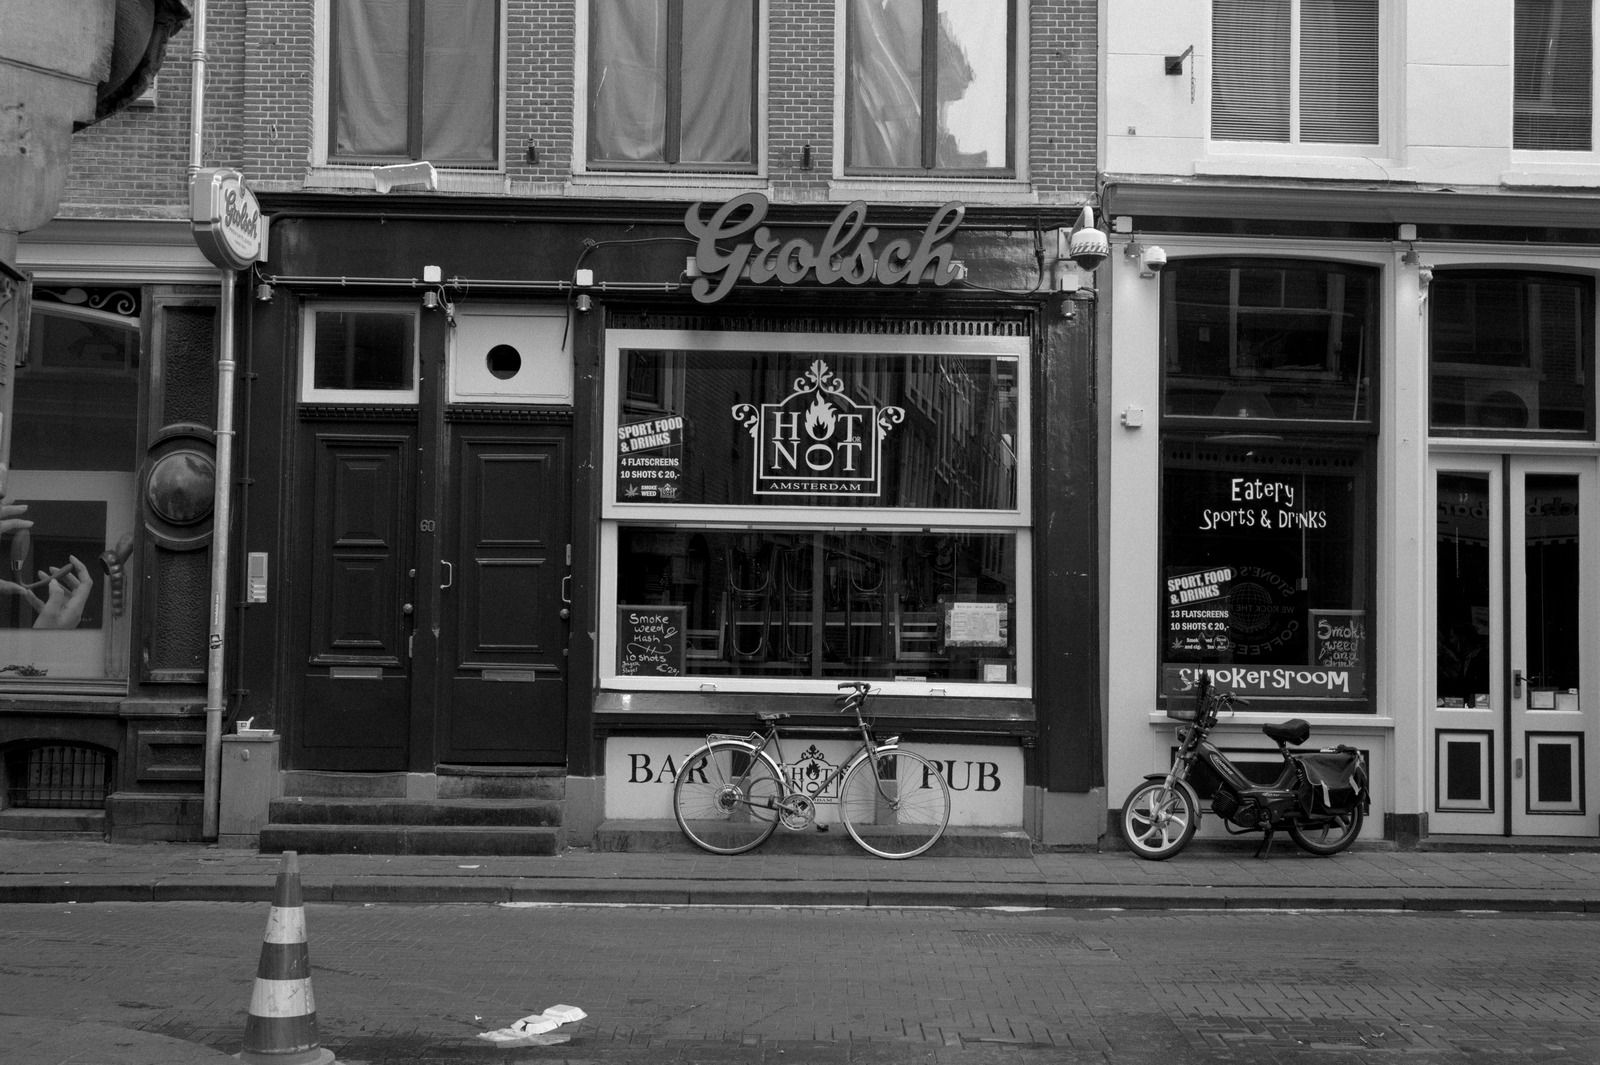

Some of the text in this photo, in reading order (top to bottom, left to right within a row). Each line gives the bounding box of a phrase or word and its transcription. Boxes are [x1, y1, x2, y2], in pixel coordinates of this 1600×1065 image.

[225, 189, 258, 240] Grolsch
[684, 192, 965, 303] Grolsch
[618, 416, 683, 440] SPORT, FOOD
[772, 402, 863, 442] HOT
[620, 432, 671, 453] & DRINKS
[621, 458, 679, 466] 4 FLATSCREENS
[771, 441, 862, 471] NOT
[620, 470, 630, 479] 10
[631, 470, 657, 479] SHOTS
[770, 482, 861, 491] AMSTERDAM
[1232, 479, 1294, 507] Eatery
[420, 519, 435, 532] 60
[1199, 508, 1255, 530] Sports
[1260, 509, 1272, 529] &
[1167, 573, 1204, 592] SPORT,
[1204, 568, 1232, 585] FOOD
[1170, 584, 1220, 605] & DRINKS
[629, 613, 669, 625] Smoke
[1170, 610, 1229, 618] 13 FLATSCREENS
[634, 624, 664, 634] weed
[1170, 622, 1180, 630] 10
[1181, 622, 1207, 630] SHOTS
[639, 654, 667, 663] shots
[628, 753, 710, 784] BAR
[791, 762, 833, 780] HOT
[919, 759, 1001, 792] PUB
